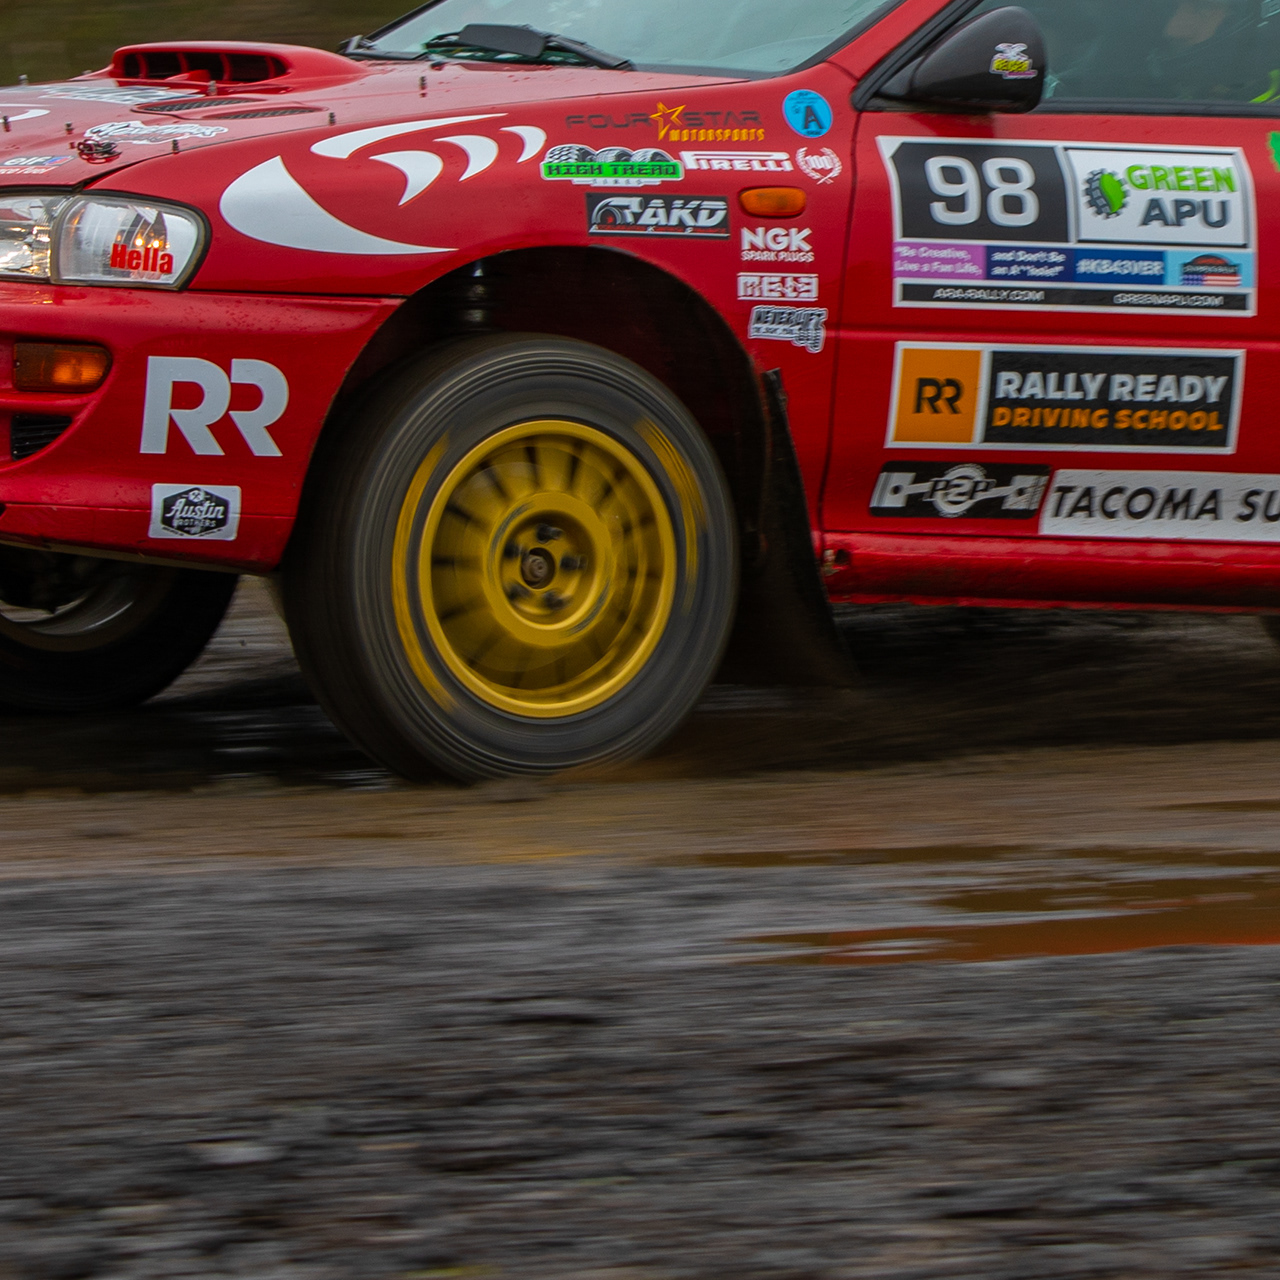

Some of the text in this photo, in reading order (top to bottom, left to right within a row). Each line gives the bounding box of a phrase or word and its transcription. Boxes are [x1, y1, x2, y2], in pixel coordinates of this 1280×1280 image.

[566, 110, 763, 129] FOUR STAR
[803, 105, 826, 130] A
[669, 128, 765, 143] MOTORSPORTS
[548, 164, 603, 175] HIGH
[679, 151, 794, 171] PIRELLI
[924, 155, 1040, 227] 98
[1126, 164, 1238, 193] GREEN
[1139, 198, 1231, 228] APU
[741, 227, 813, 251] NGK
[110, 243, 174, 274] Hella
[741, 251, 815, 262] SPARK PLUGS
[915, 377, 964, 415] RR
[995, 371, 1229, 403] RALLY READY
[139, 355, 290, 457] RR
[991, 407, 1225, 431] DRIVING SCHOOL
[164, 498, 226, 518] Austin
[1053, 485, 1223, 521] TACOMA
